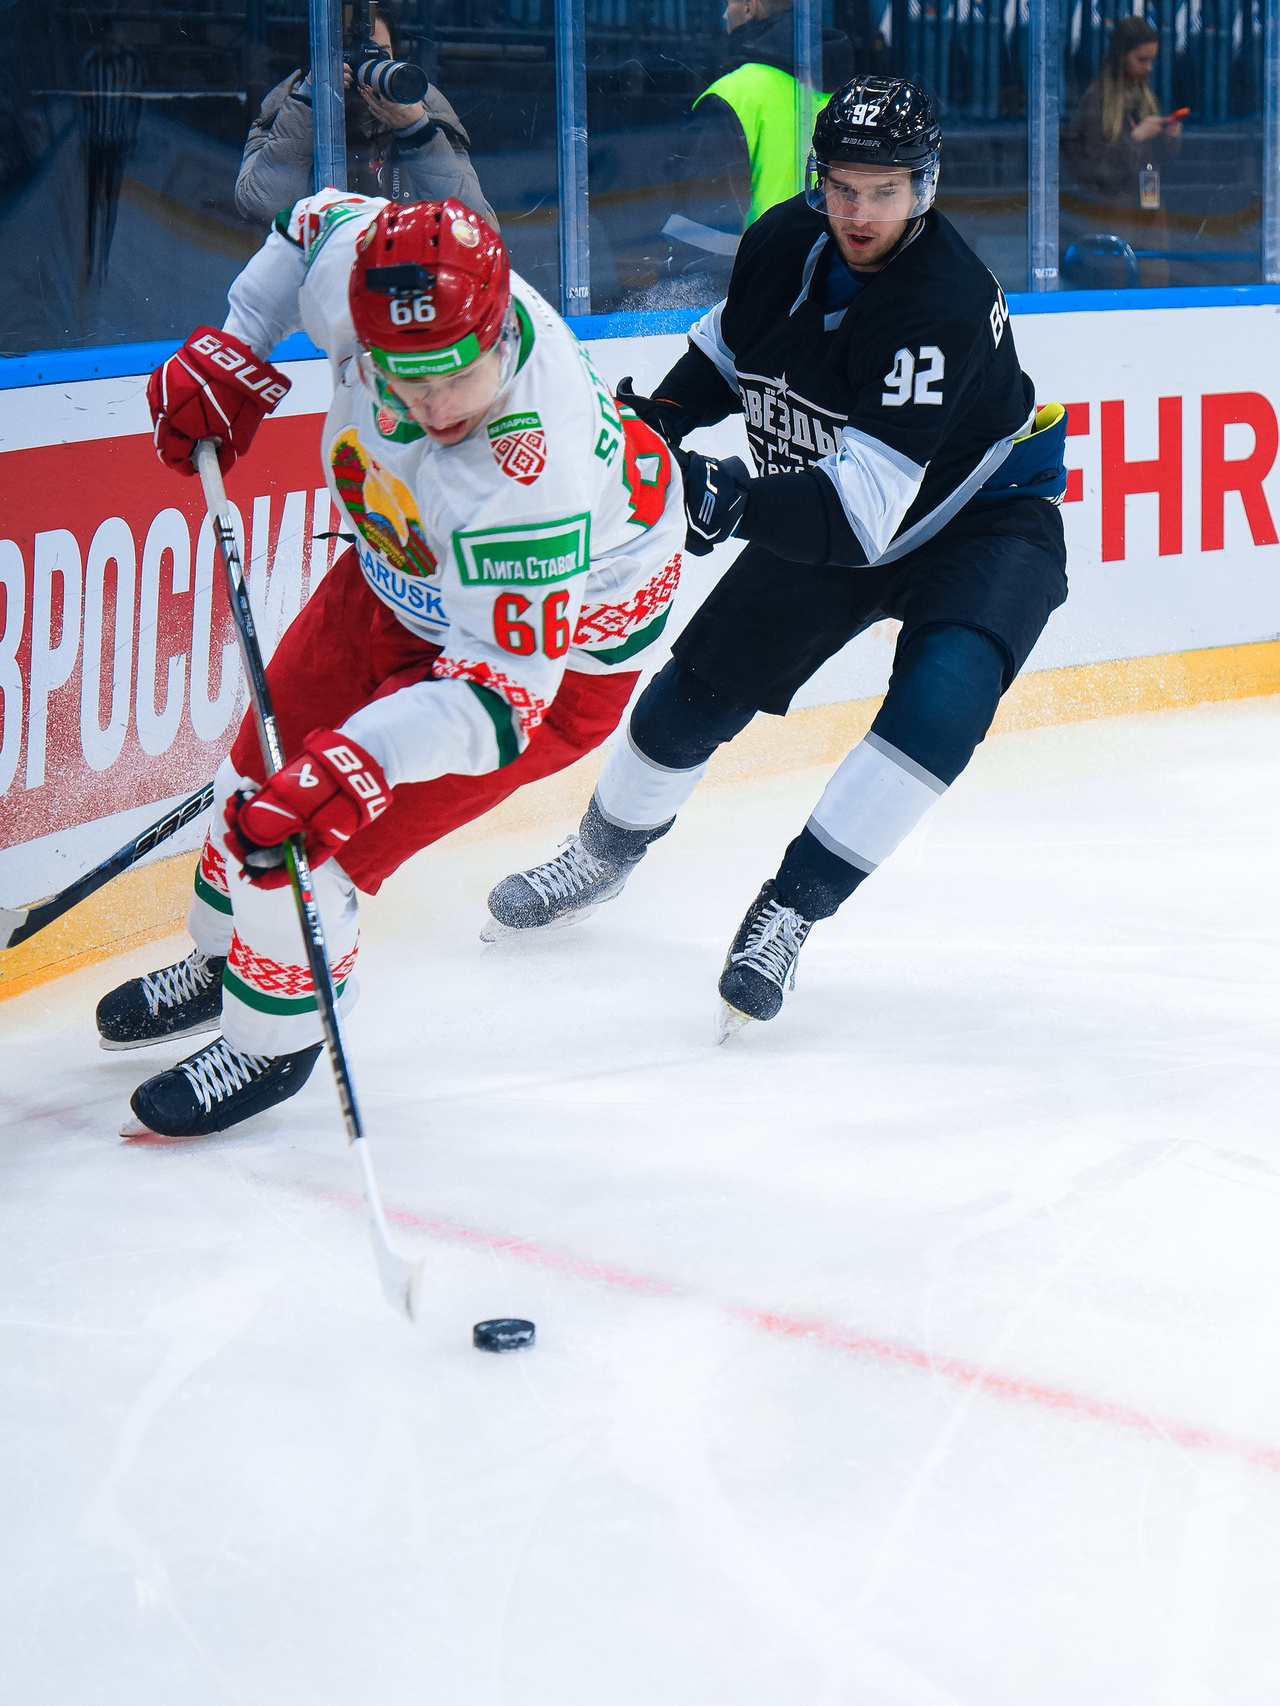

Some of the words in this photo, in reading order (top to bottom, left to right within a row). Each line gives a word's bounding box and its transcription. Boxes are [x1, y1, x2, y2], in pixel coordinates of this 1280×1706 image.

[852, 104, 880, 126] 92
[392, 167, 400, 199] Canon
[389, 296, 437, 325] 66
[881, 345, 946, 407] 92
[494, 590, 570, 660] 66
